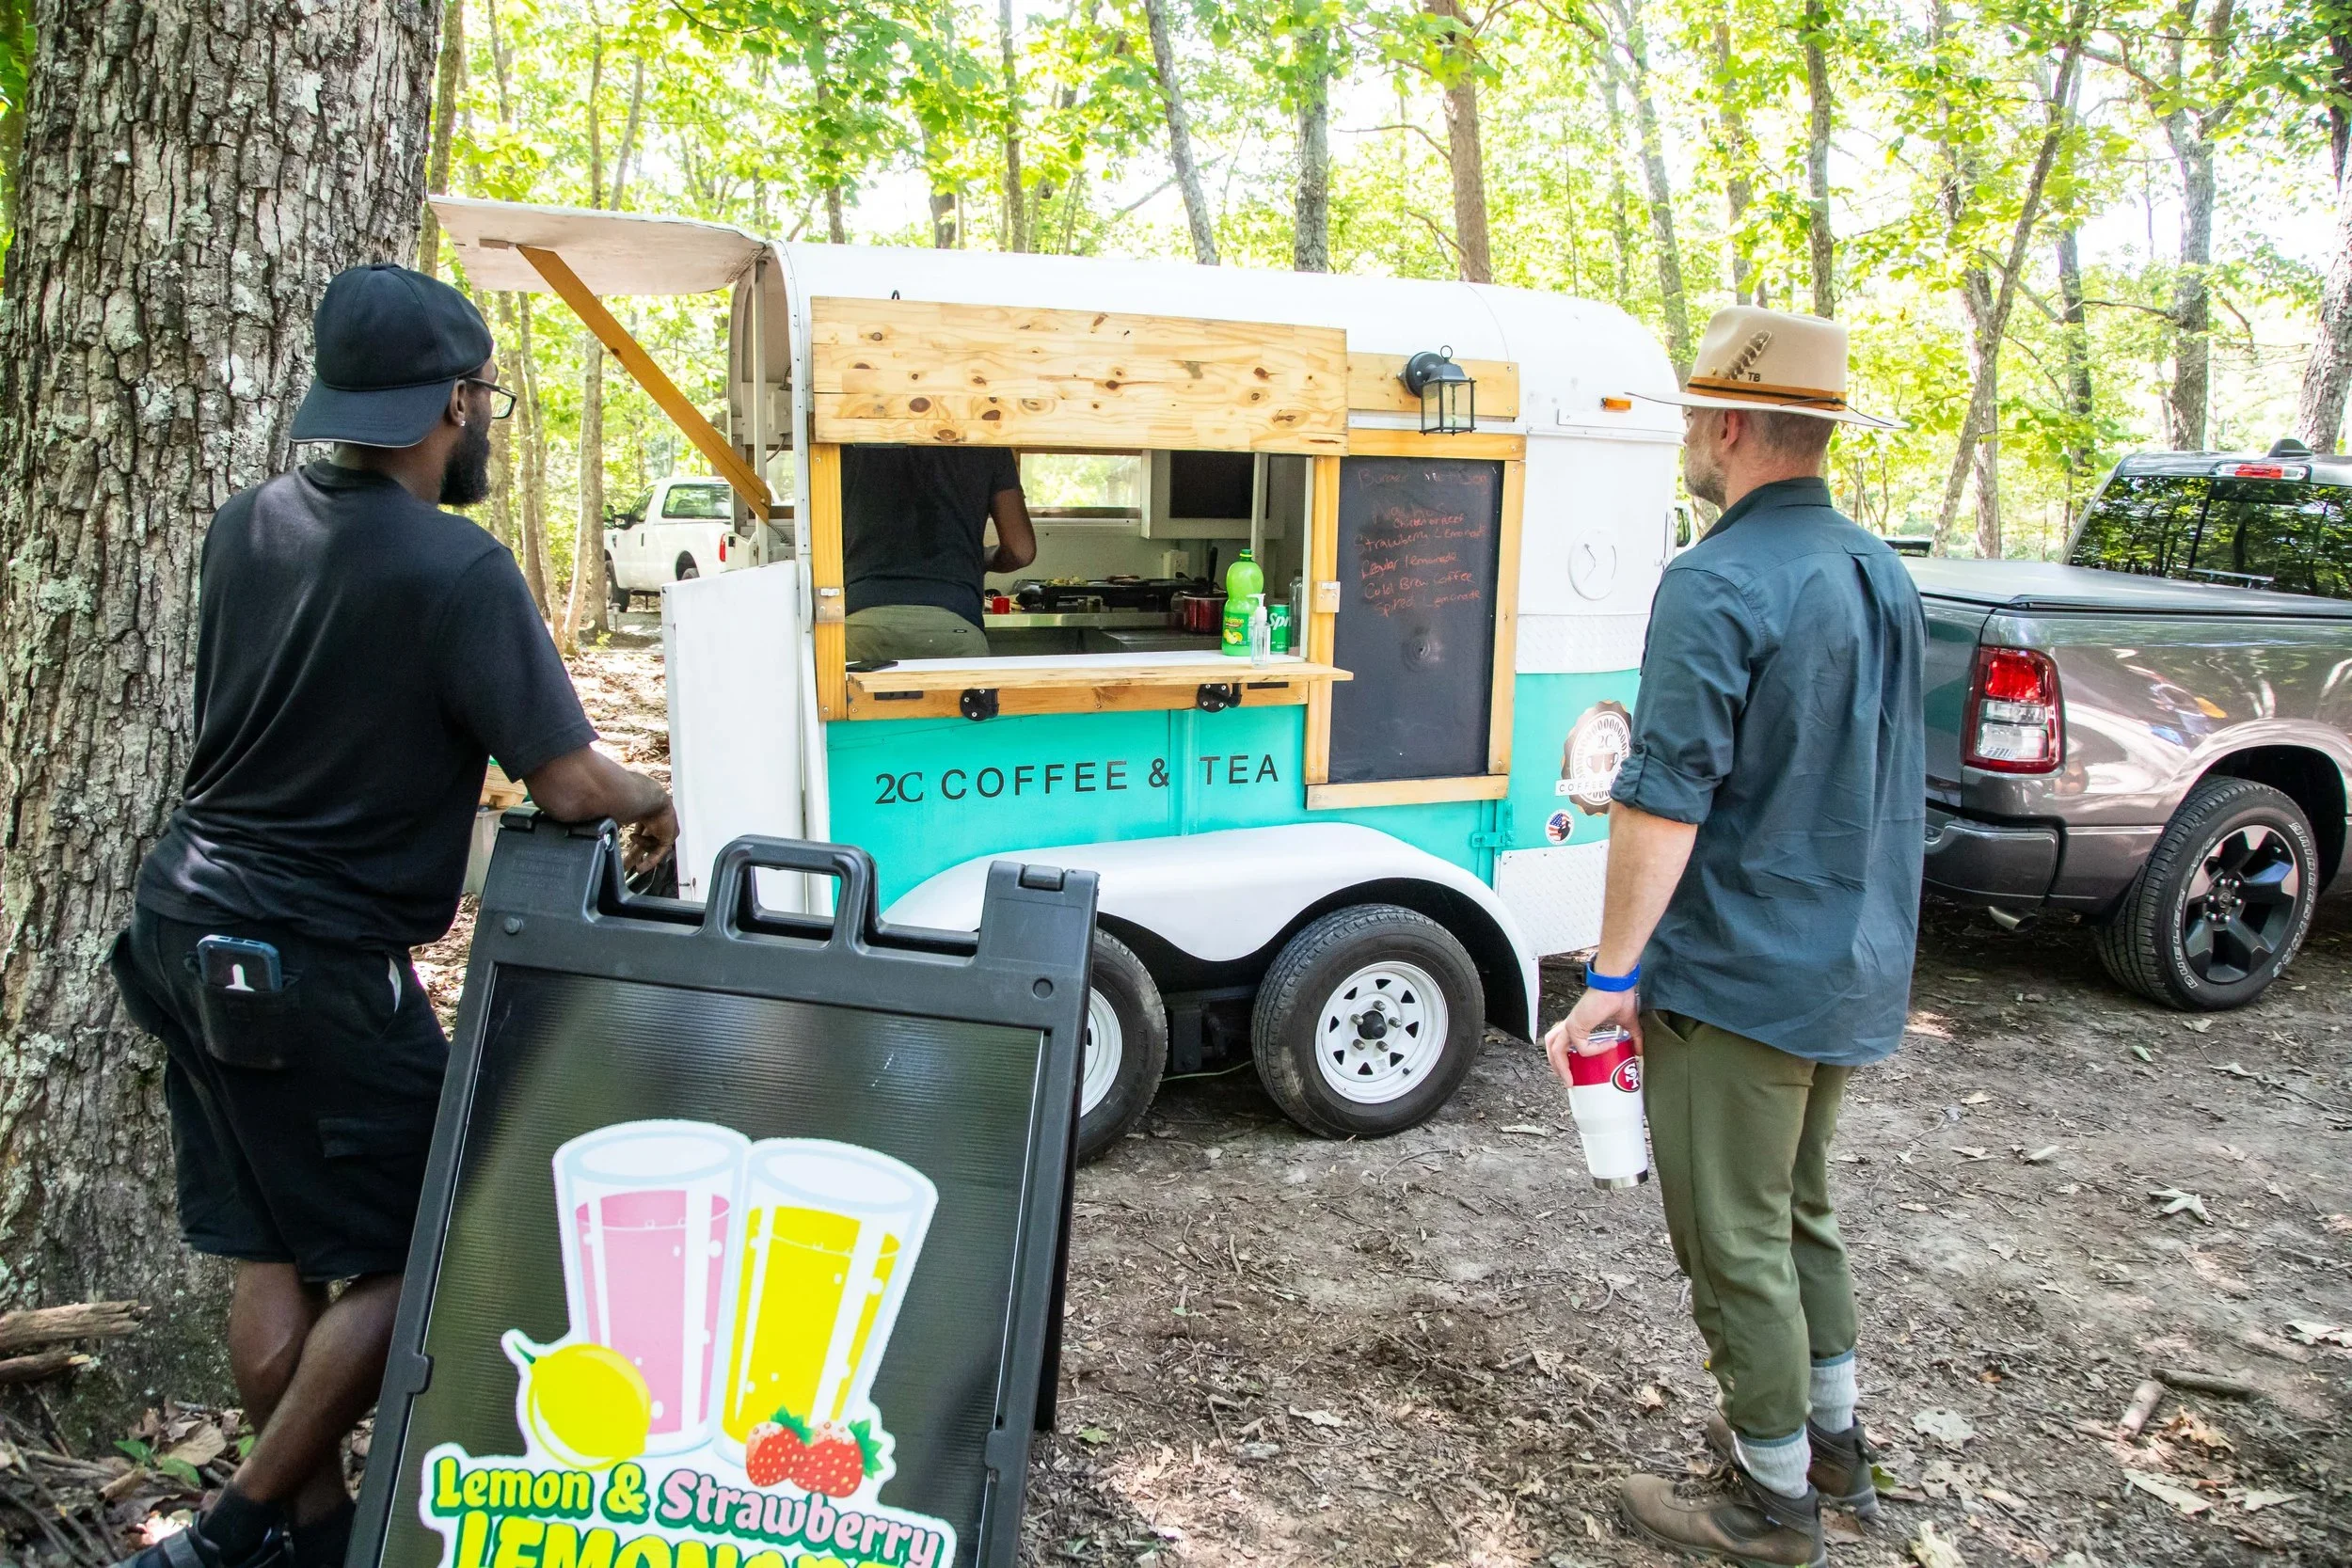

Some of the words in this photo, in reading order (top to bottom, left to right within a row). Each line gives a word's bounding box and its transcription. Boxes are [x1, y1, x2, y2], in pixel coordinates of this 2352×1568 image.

[1748, 372, 1760, 382] TB
[875, 771, 924, 804] 2C
[941, 761, 1127, 800] COFFEE
[1148, 757, 1170, 788] &
[1200, 753, 1279, 784] TEA
[1559, 780, 1604, 793] COFFEE
[434, 1457, 595, 1515] Lemon
[601, 1462, 651, 1523] &
[657, 1468, 944, 1568] Strawberry
